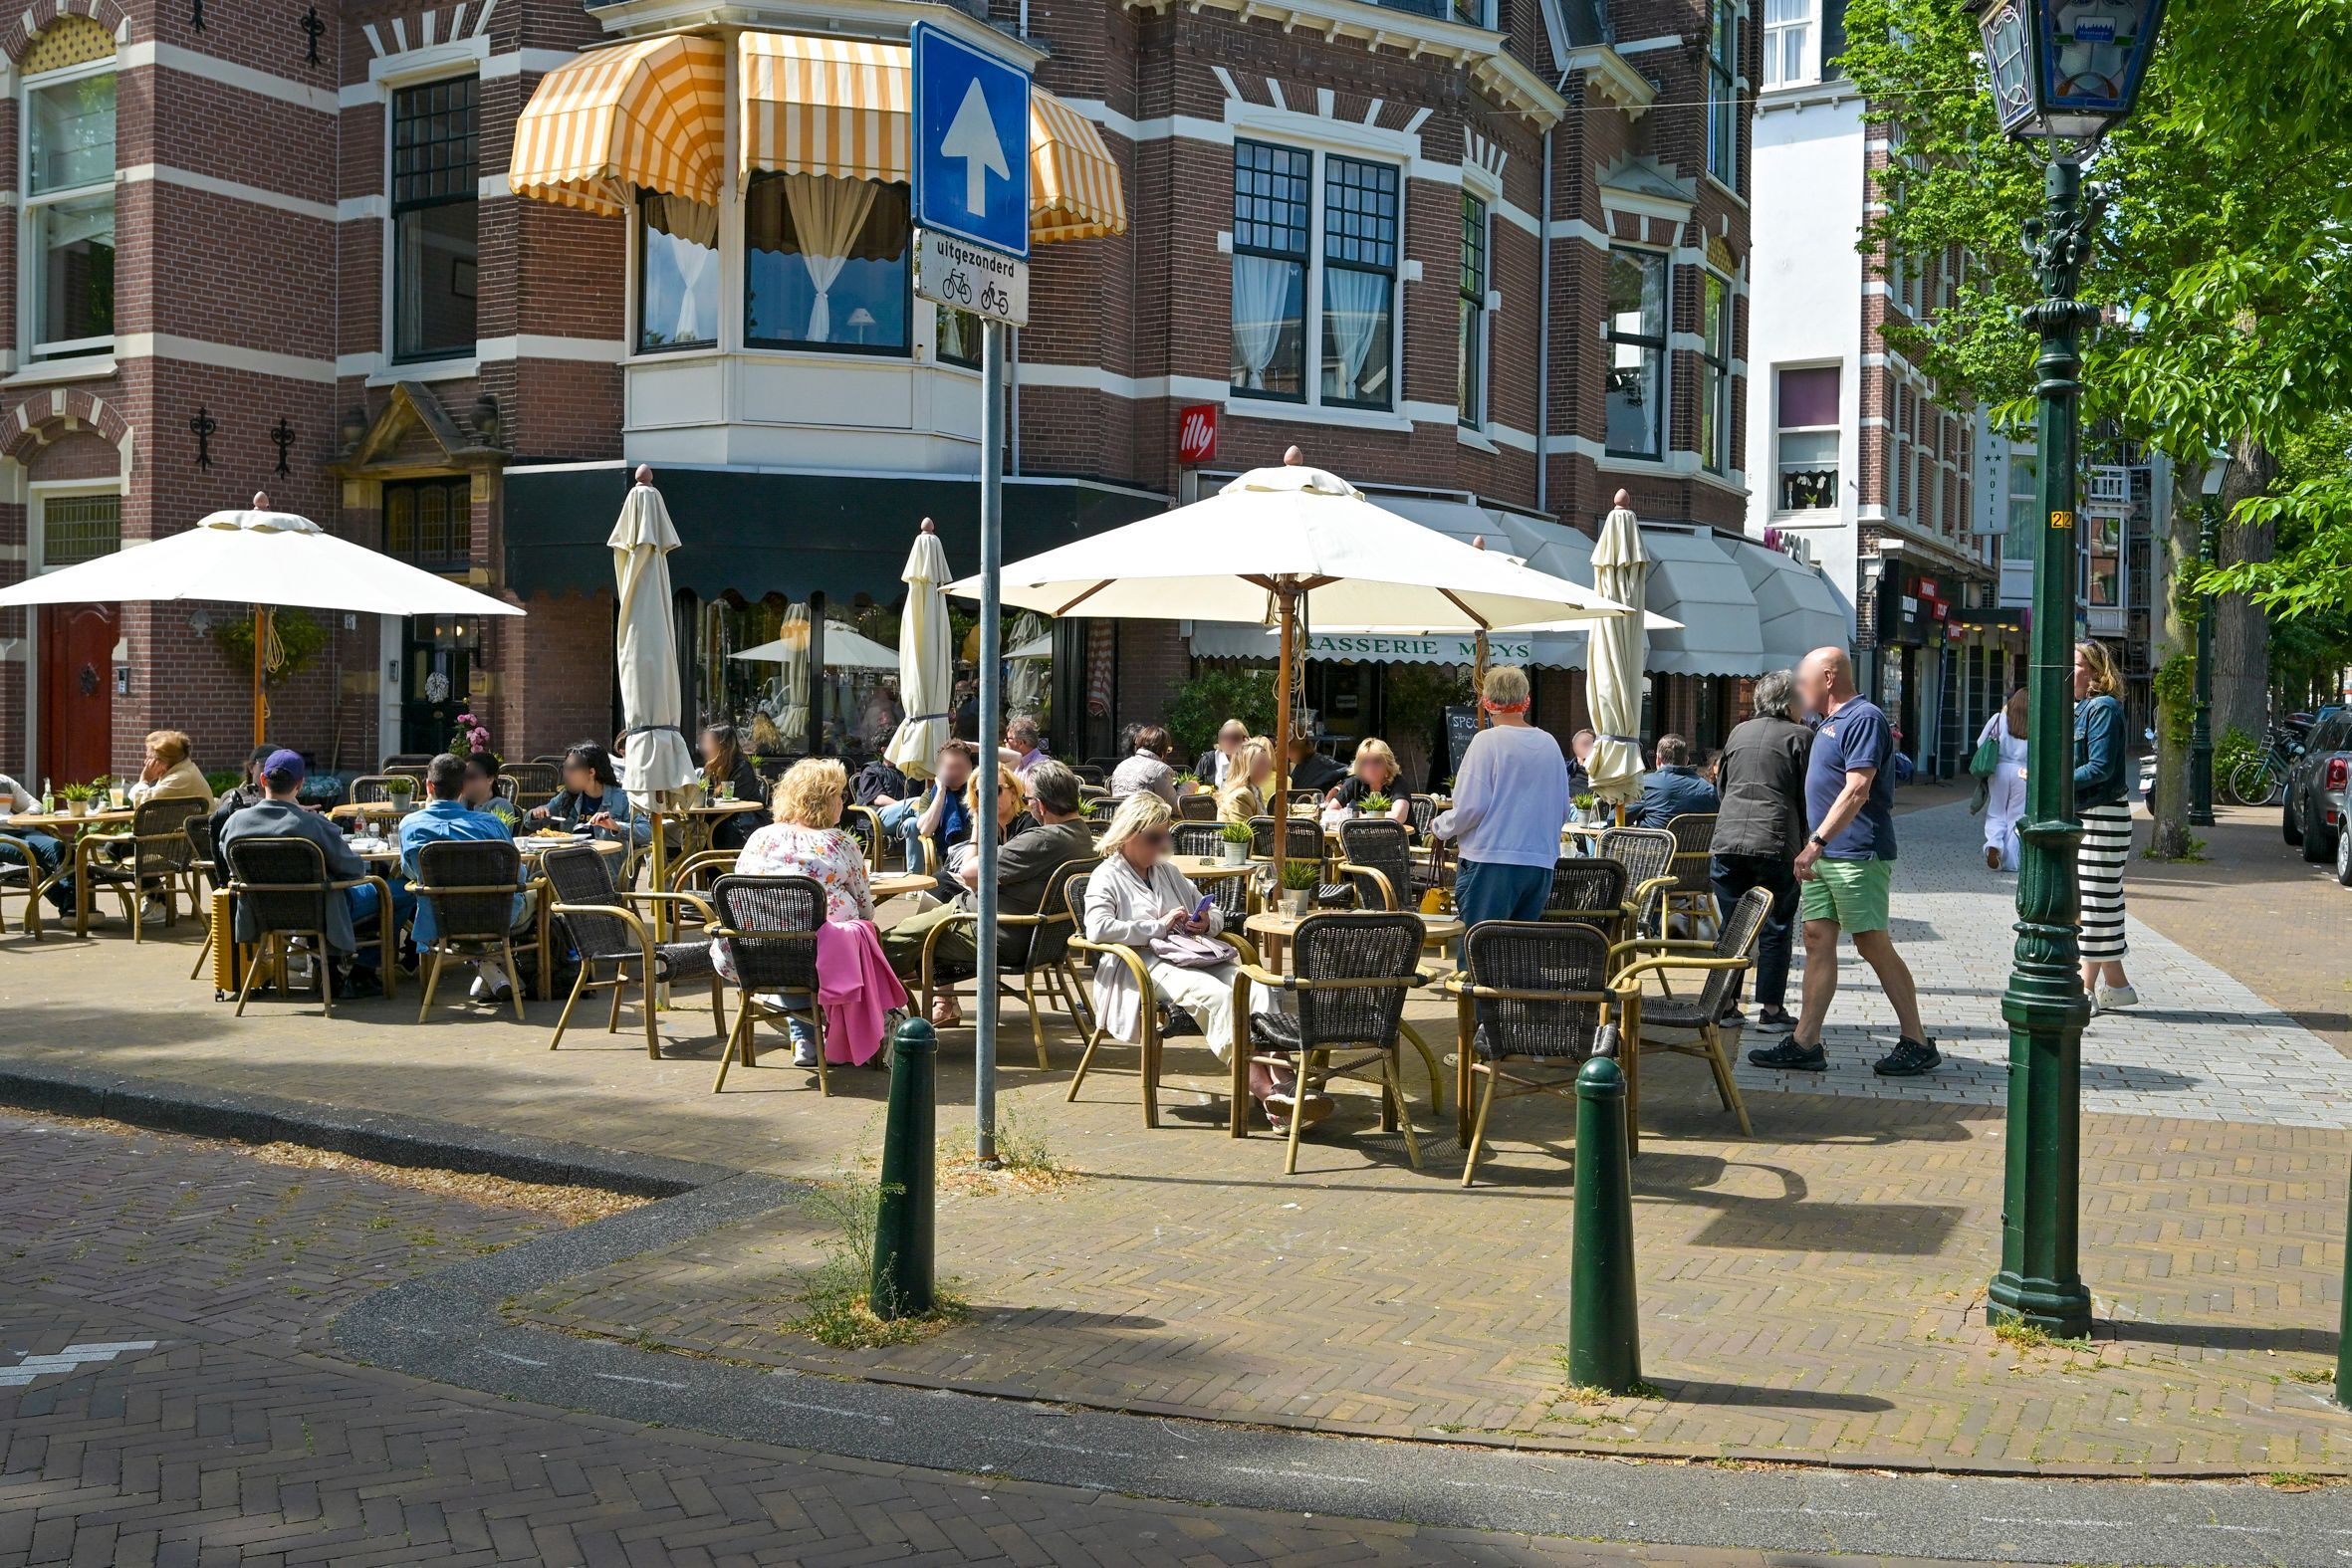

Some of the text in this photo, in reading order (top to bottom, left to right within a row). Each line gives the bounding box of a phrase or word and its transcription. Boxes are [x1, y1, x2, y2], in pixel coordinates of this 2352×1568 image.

[937, 240, 1015, 278] uitgezonderd
[1181, 413, 1213, 458] illy
[2052, 512, 2072, 528] 22
[1279, 635, 1439, 656] RASSERIE
